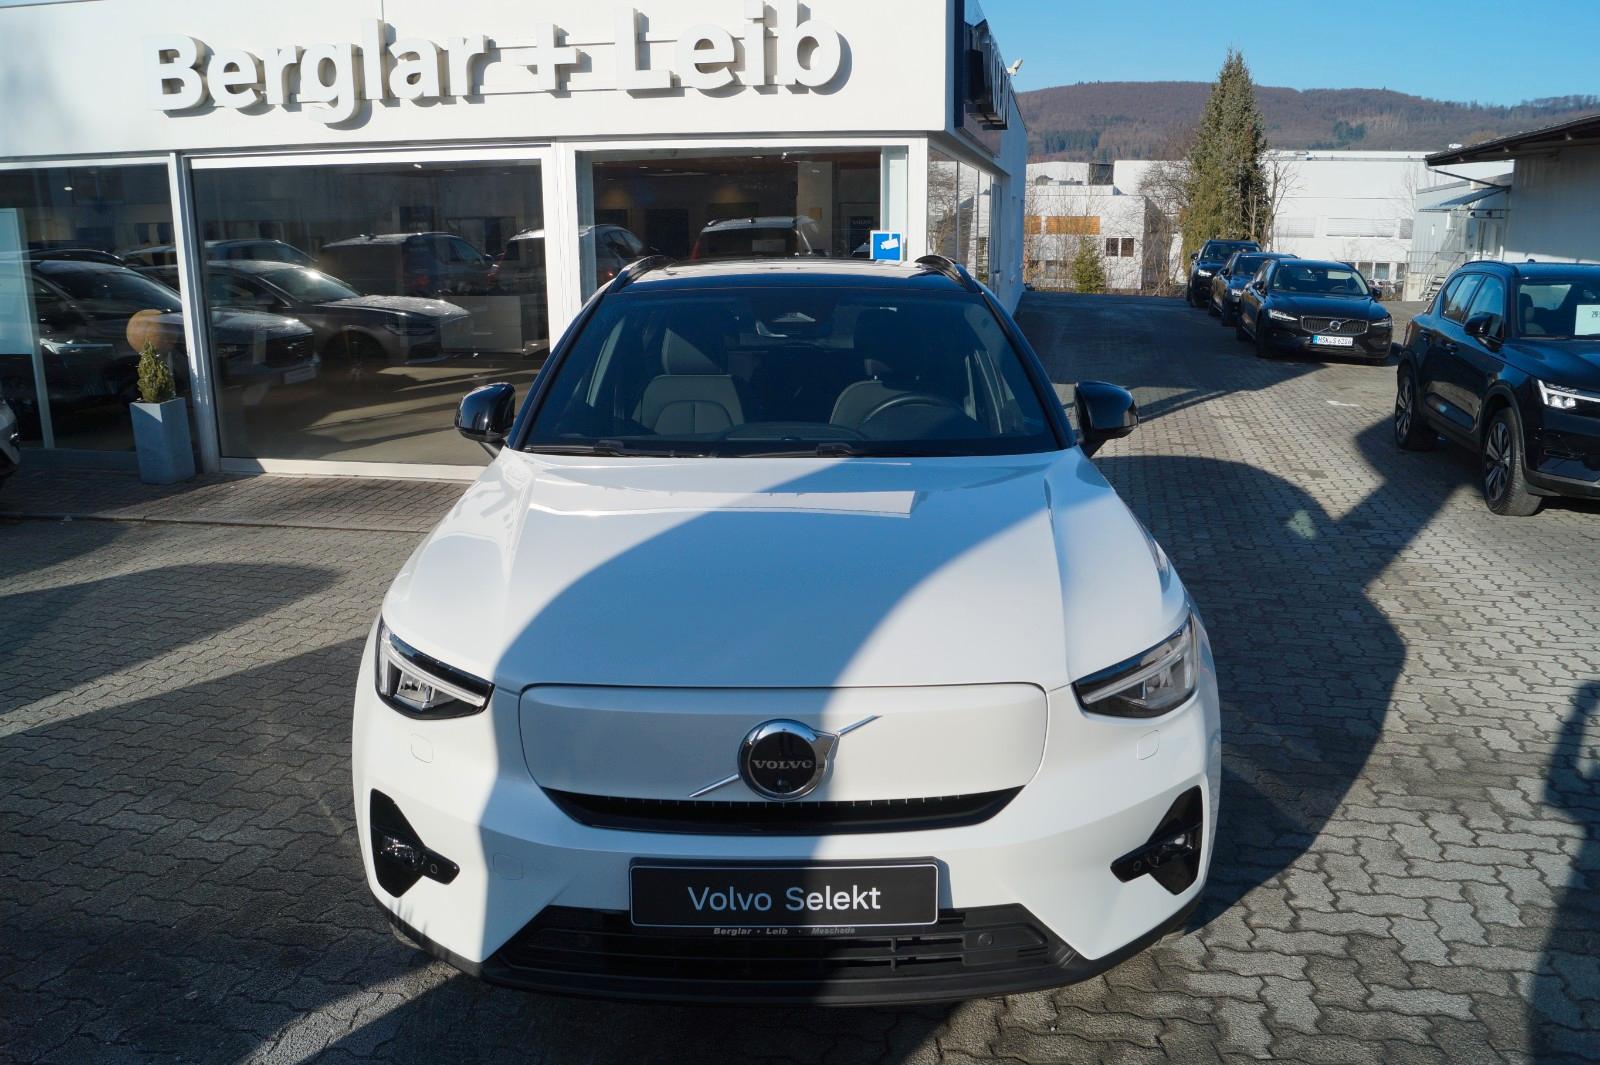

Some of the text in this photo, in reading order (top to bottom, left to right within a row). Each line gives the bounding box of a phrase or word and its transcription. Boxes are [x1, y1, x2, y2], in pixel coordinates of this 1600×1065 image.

[146, 0, 844, 126] Berglar + Leib
[752, 759, 814, 770] VOLVO
[687, 885, 882, 911] Volvo Selekt
[713, 927, 753, 937] Berglar
[765, 927, 789, 936] Leib
